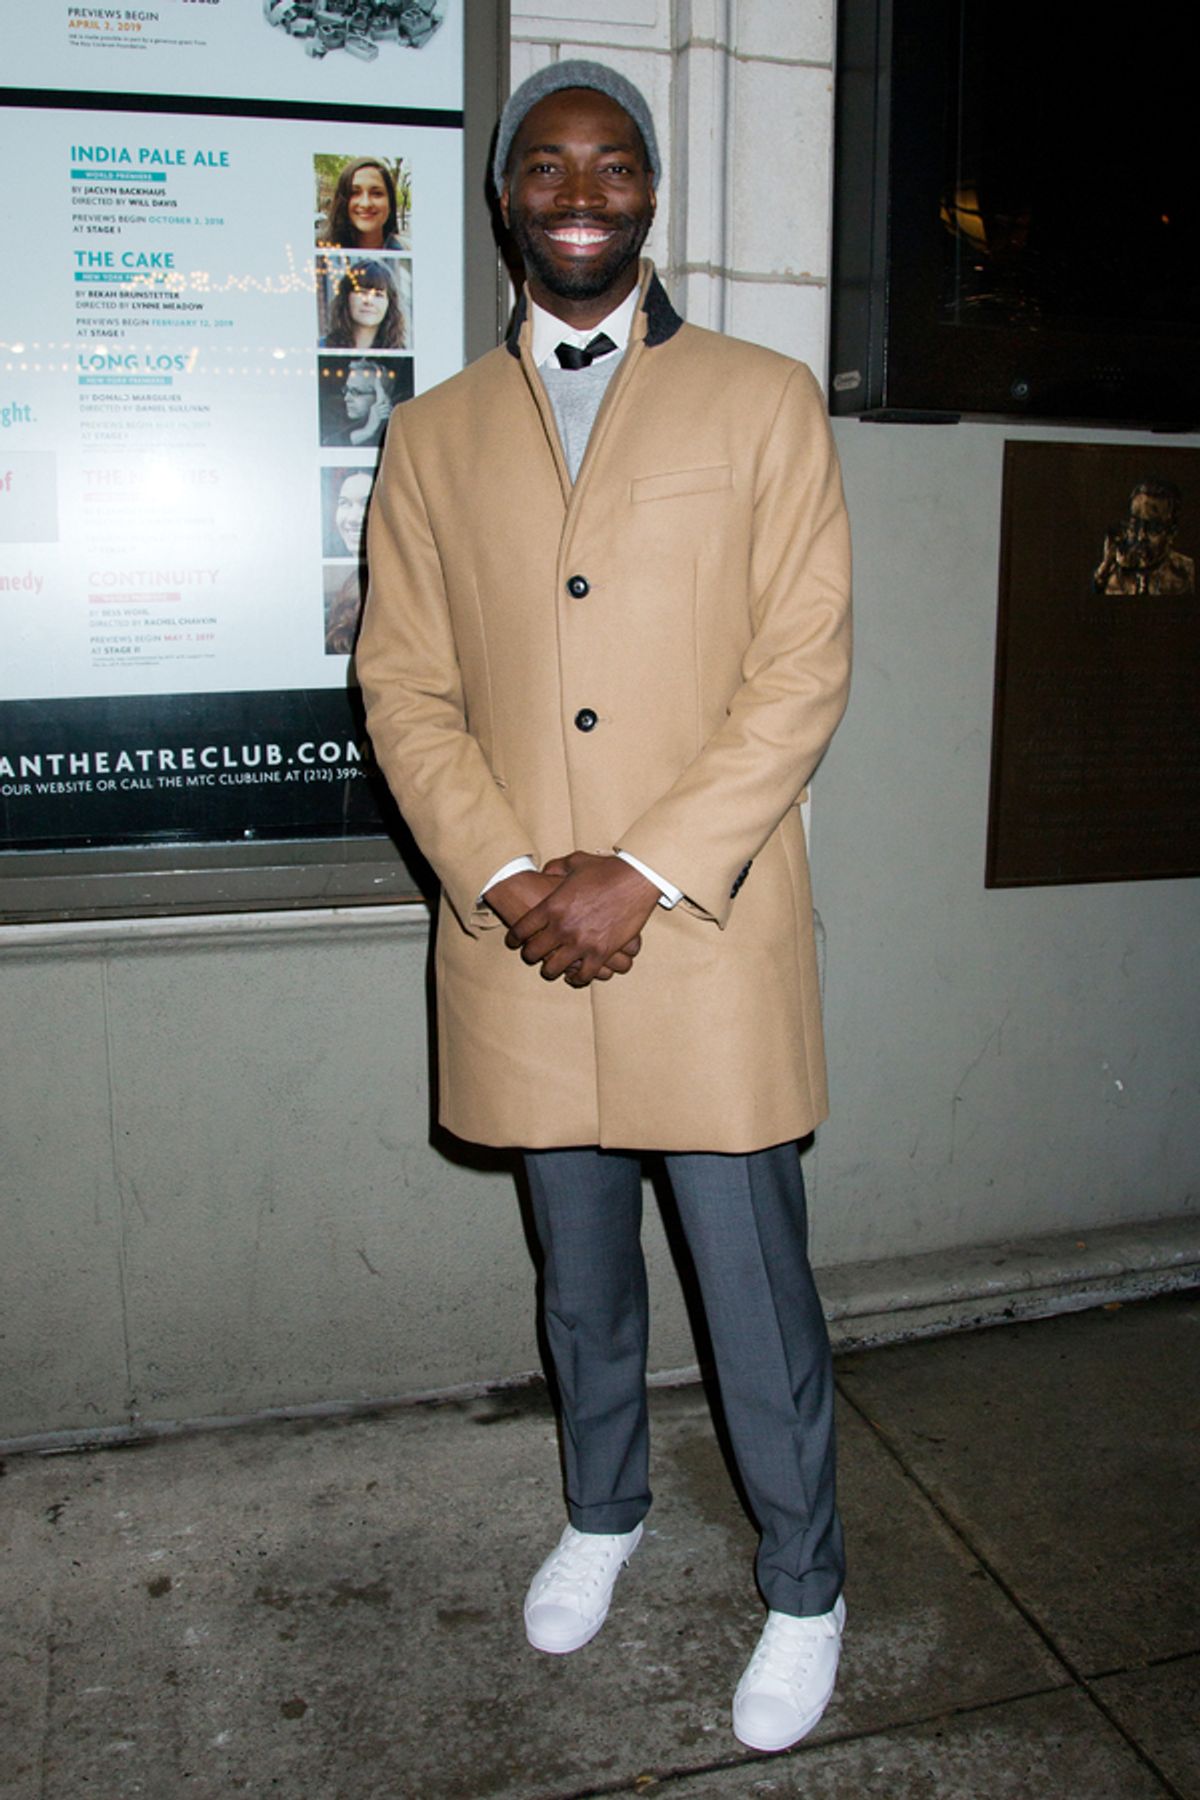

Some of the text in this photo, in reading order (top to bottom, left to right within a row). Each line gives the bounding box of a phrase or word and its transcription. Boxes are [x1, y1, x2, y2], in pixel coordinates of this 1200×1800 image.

[67, 7, 159, 22] PREVIEWS BEGIN
[68, 20, 101, 30] APRIL
[117, 22, 142, 32] 2019
[70, 145, 230, 167] INDIA PALE ALE
[85, 171, 114, 180] WORLD
[72, 186, 166, 197] BY JACLYN BACKHAUS
[72, 197, 178, 208] DIRECTED BY WILL DAVIS
[72, 214, 117, 223] PREVIEWS
[118, 215, 147, 224] BEGIN
[148, 216, 192, 225] OCTOBER
[73, 225, 84, 234] AT
[86, 226, 115, 234] STAGE
[74, 250, 176, 269] THE CAKE
[75, 290, 181, 300] BY BEKAH BRUNSTETTER
[75, 301, 204, 311] DIRECTED BY LYNNE MEADOW
[76, 318, 120, 327] PREVIEWS
[121, 319, 150, 327] BEGIN
[151, 319, 198, 328] FEBRUARY
[77, 329, 88, 338] AT
[90, 330, 119, 338] STAGE
[78, 353, 139, 371] LONG
[79, 393, 90, 402] BY
[91, 393, 129, 402] DONALD
[79, 404, 121, 413] DIRECTED
[82, 468, 123, 486] THE
[88, 569, 220, 588] CONTINUITY
[89, 619, 129, 628] DIRECTED
[143, 617, 177, 627] RACHEL
[177, 616, 218, 626] CHAVKIN
[89, 634, 133, 644] PREVIEWS
[134, 634, 162, 643] BEGIN
[163, 633, 184, 642] MAY
[90, 646, 102, 655] AT
[103, 645, 132, 654] STAGE
[1, 782, 32, 797] OUR
[35, 779, 93, 795] WEBSITE
[95, 779, 118, 792] OR
[119, 777, 154, 791] CALL
[156, 775, 183, 789] THE
[185, 773, 216, 788] MTC
[218, 770, 282, 786] CLUBLINE
[284, 769, 301, 782] AT
[303, 768, 334, 784] (212)
